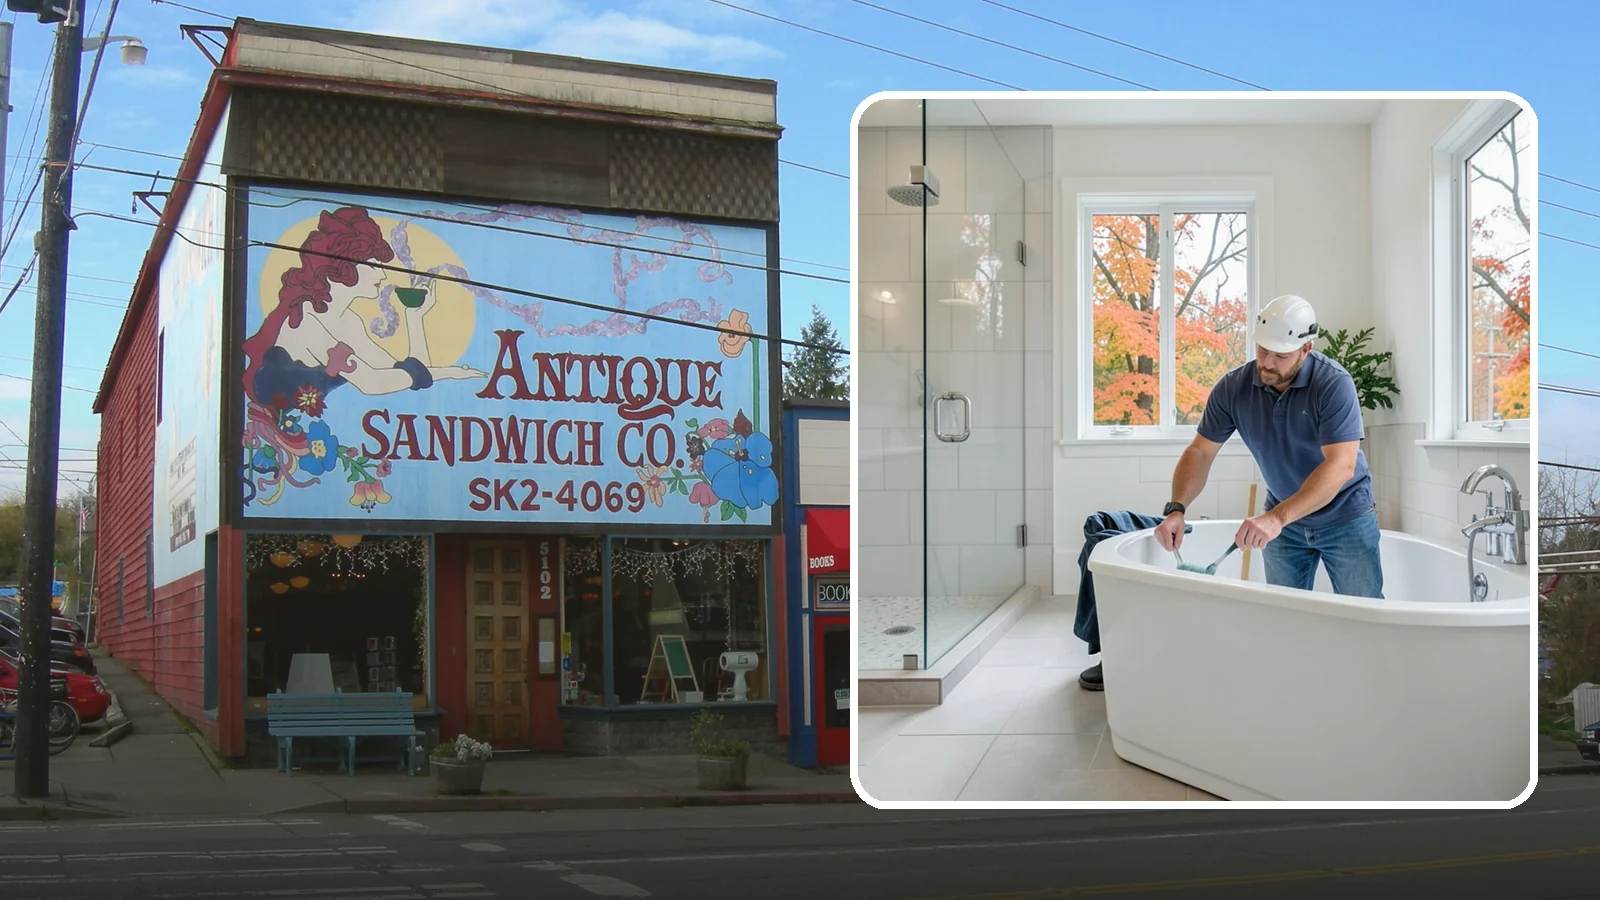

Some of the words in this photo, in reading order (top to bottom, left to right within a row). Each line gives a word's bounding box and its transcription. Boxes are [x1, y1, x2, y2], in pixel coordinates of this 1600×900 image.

[476, 329, 723, 420] ANTIQUE
[361, 408, 605, 466] SANDWICH
[616, 421, 684, 468] CO.
[468, 477, 646, 513] SK2-4069
[539, 542, 551, 599] 5102
[809, 554, 835, 569] BOOKS
